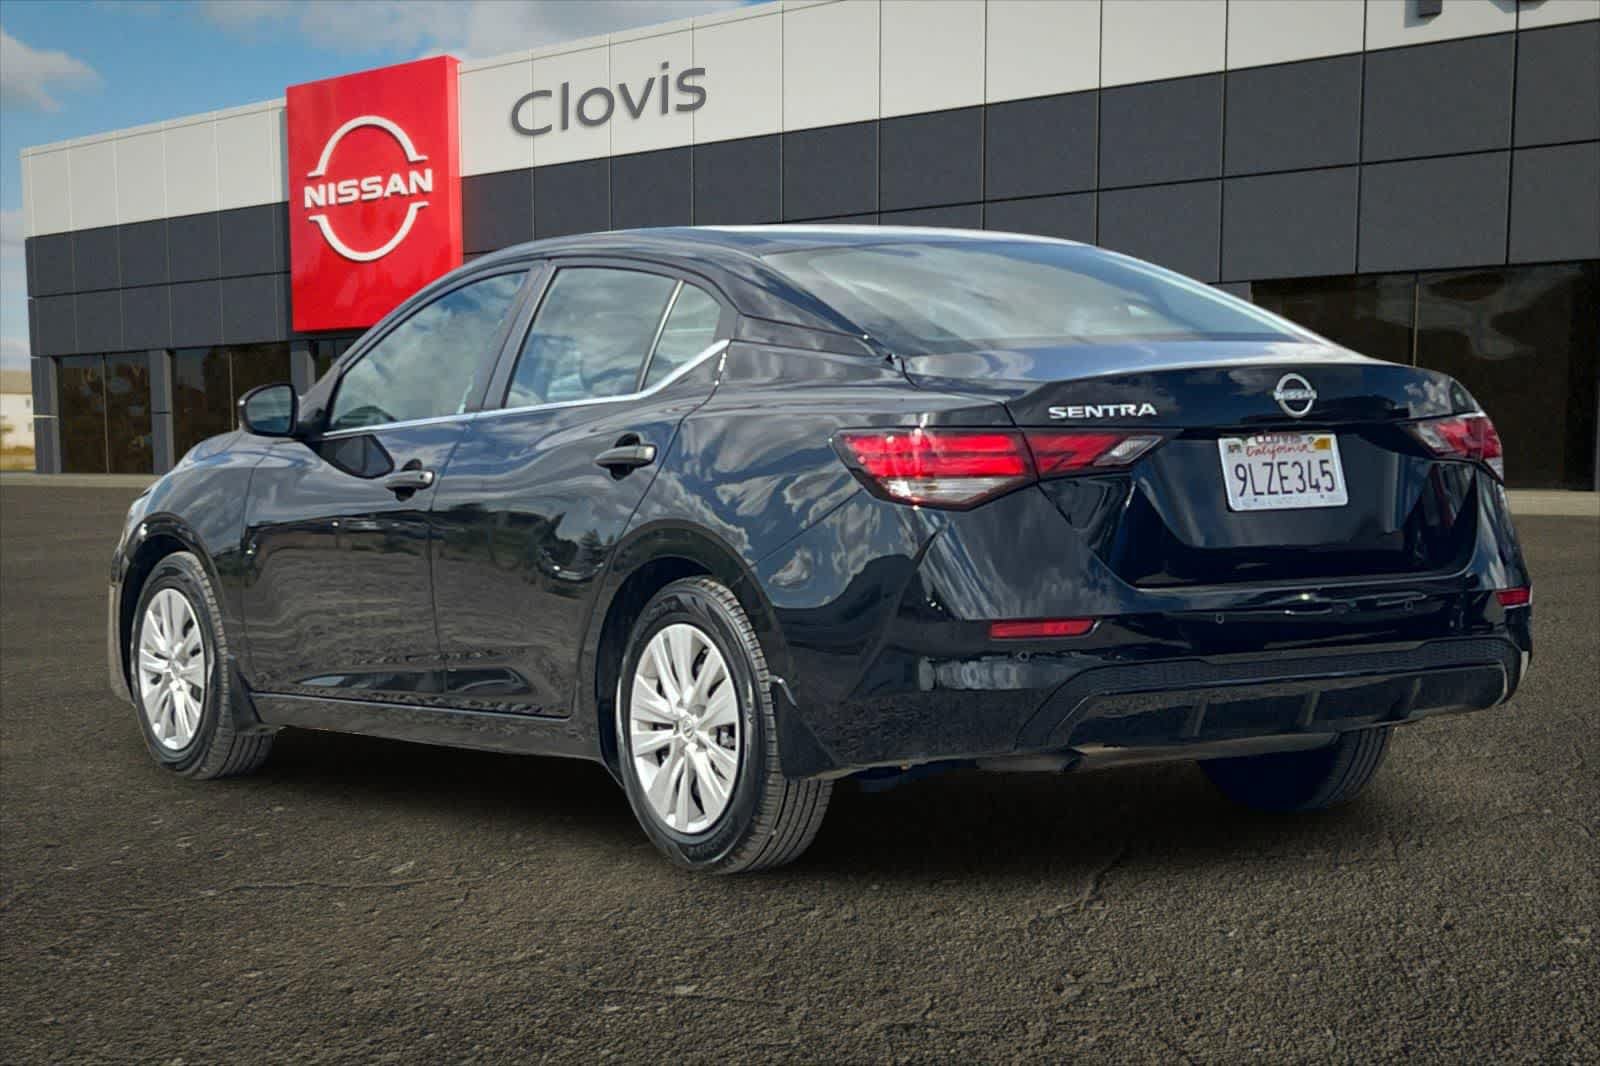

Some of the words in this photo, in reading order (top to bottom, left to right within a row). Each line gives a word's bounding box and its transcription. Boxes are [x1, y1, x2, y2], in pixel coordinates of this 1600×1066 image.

[511, 61, 708, 136] Clovis
[303, 168, 433, 209] NISSAN
[1274, 390, 1317, 401] NISSAN
[1048, 403, 1157, 419] SENTRA
[1246, 443, 1311, 460] California
[1234, 459, 1336, 497] 9LZE345
